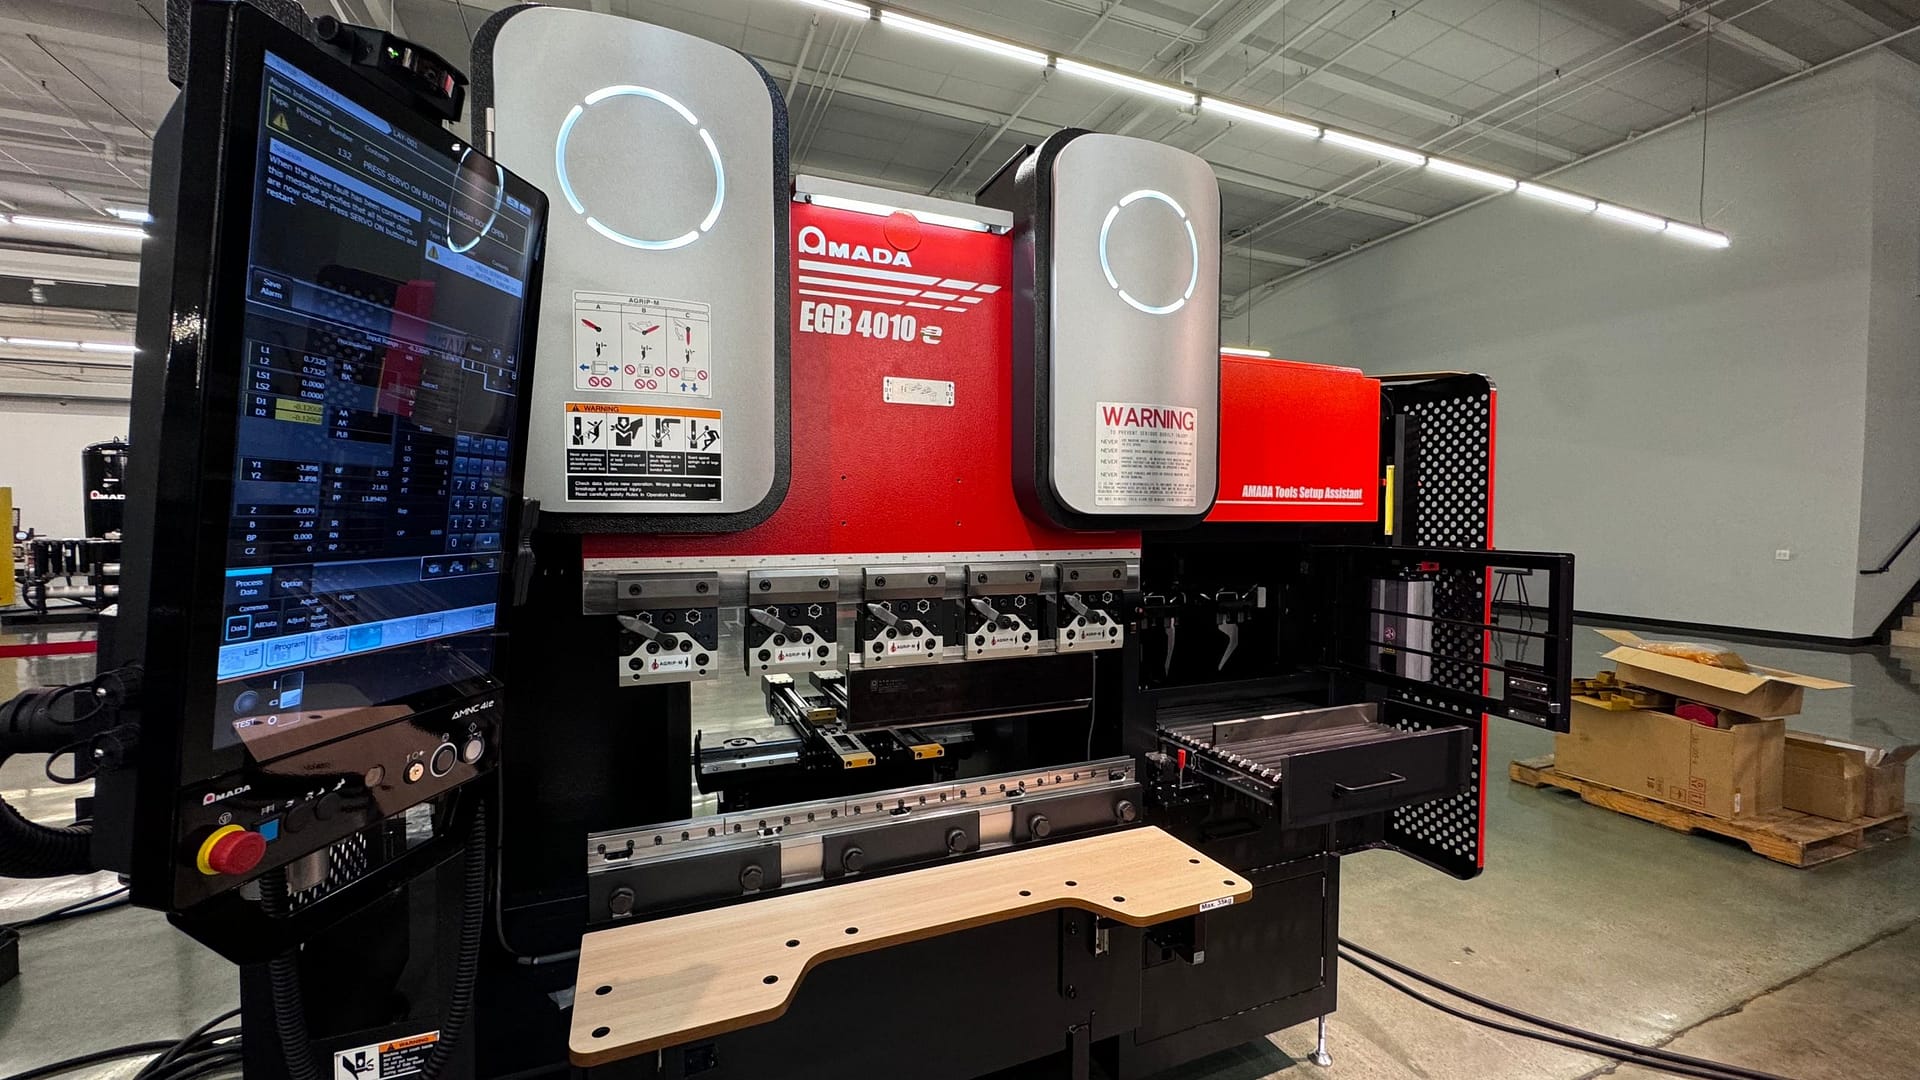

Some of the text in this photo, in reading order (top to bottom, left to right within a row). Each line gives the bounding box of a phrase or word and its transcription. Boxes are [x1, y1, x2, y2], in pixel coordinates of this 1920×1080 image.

[272, 94, 288, 108] Type
[296, 108, 322, 126] Process
[329, 125, 352, 142] Number
[269, 154, 380, 211] When the above fault has been
[338, 148, 352, 160] 132
[364, 160, 386, 178] PRESS
[387, 173, 410, 189] SERVO
[410, 184, 422, 196] ON
[422, 191, 447, 210] BUTTON
[452, 206, 475, 223] THROAT
[268, 166, 284, 178] this
[286, 174, 320, 194] message
[320, 190, 351, 208] specifies
[376, 213, 396, 226] throat
[396, 221, 413, 236] doors
[267, 178, 281, 188] are
[283, 184, 300, 196] now
[330, 204, 350, 218] Press
[350, 212, 373, 227] SERVO
[374, 222, 384, 232] ON
[386, 227, 406, 241] button
[406, 235, 418, 246] and
[798, 226, 912, 268] AMADA
[264, 278, 282, 290] Save
[260, 287, 282, 300] Alarm
[800, 300, 852, 336] EGB
[856, 310, 917, 342] 4010
[260, 357, 326, 376] L2 0.7325
[256, 371, 325, 390] LS1 0.0000
[256, 382, 324, 400] LS2 0.0000
[256, 398, 267, 406] D1
[256, 408, 266, 416] D2
[1102, 406, 1194, 431] WARNING
[456, 480, 488, 490] 7 8 9
[1242, 484, 1364, 500] AMADA Tools Setup Assistant
[454, 500, 487, 509] 4 5 6
[454, 519, 486, 528] 1 2 3
[452, 538, 457, 548] 0
[274, 640, 306, 651] Program
[326, 634, 346, 642] Setup
[244, 648, 258, 656] List
[452, 704, 480, 720] AMNC
[235, 718, 256, 728] TEST
[202, 784, 251, 806] AMADA
